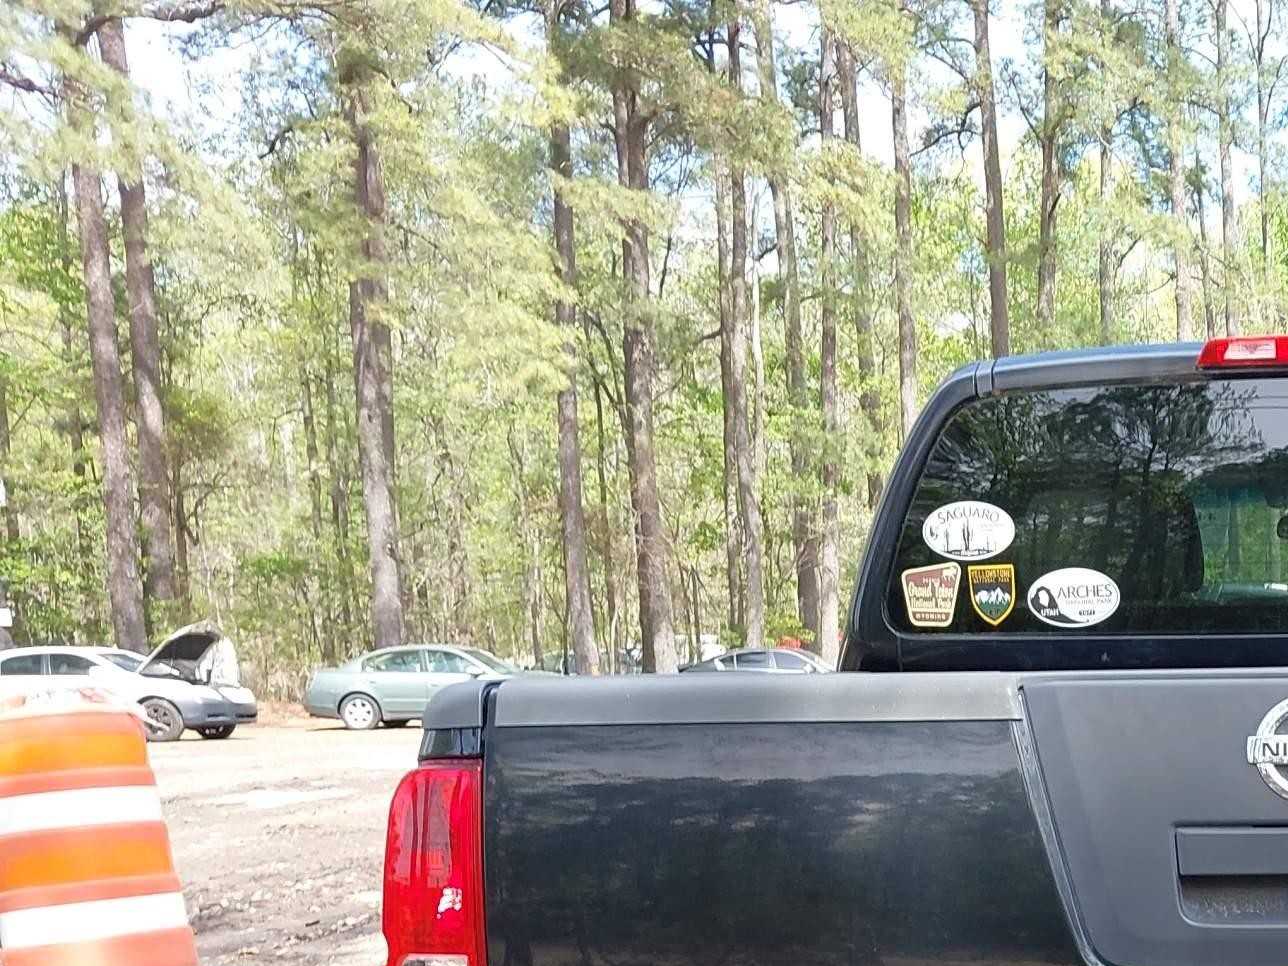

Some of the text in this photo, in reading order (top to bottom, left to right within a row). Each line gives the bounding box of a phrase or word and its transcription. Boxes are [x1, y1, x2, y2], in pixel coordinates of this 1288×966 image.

[937, 505, 999, 525] SAGUARO
[1057, 584, 1112, 599] ARCHES
[1041, 607, 1059, 617] UTAH
